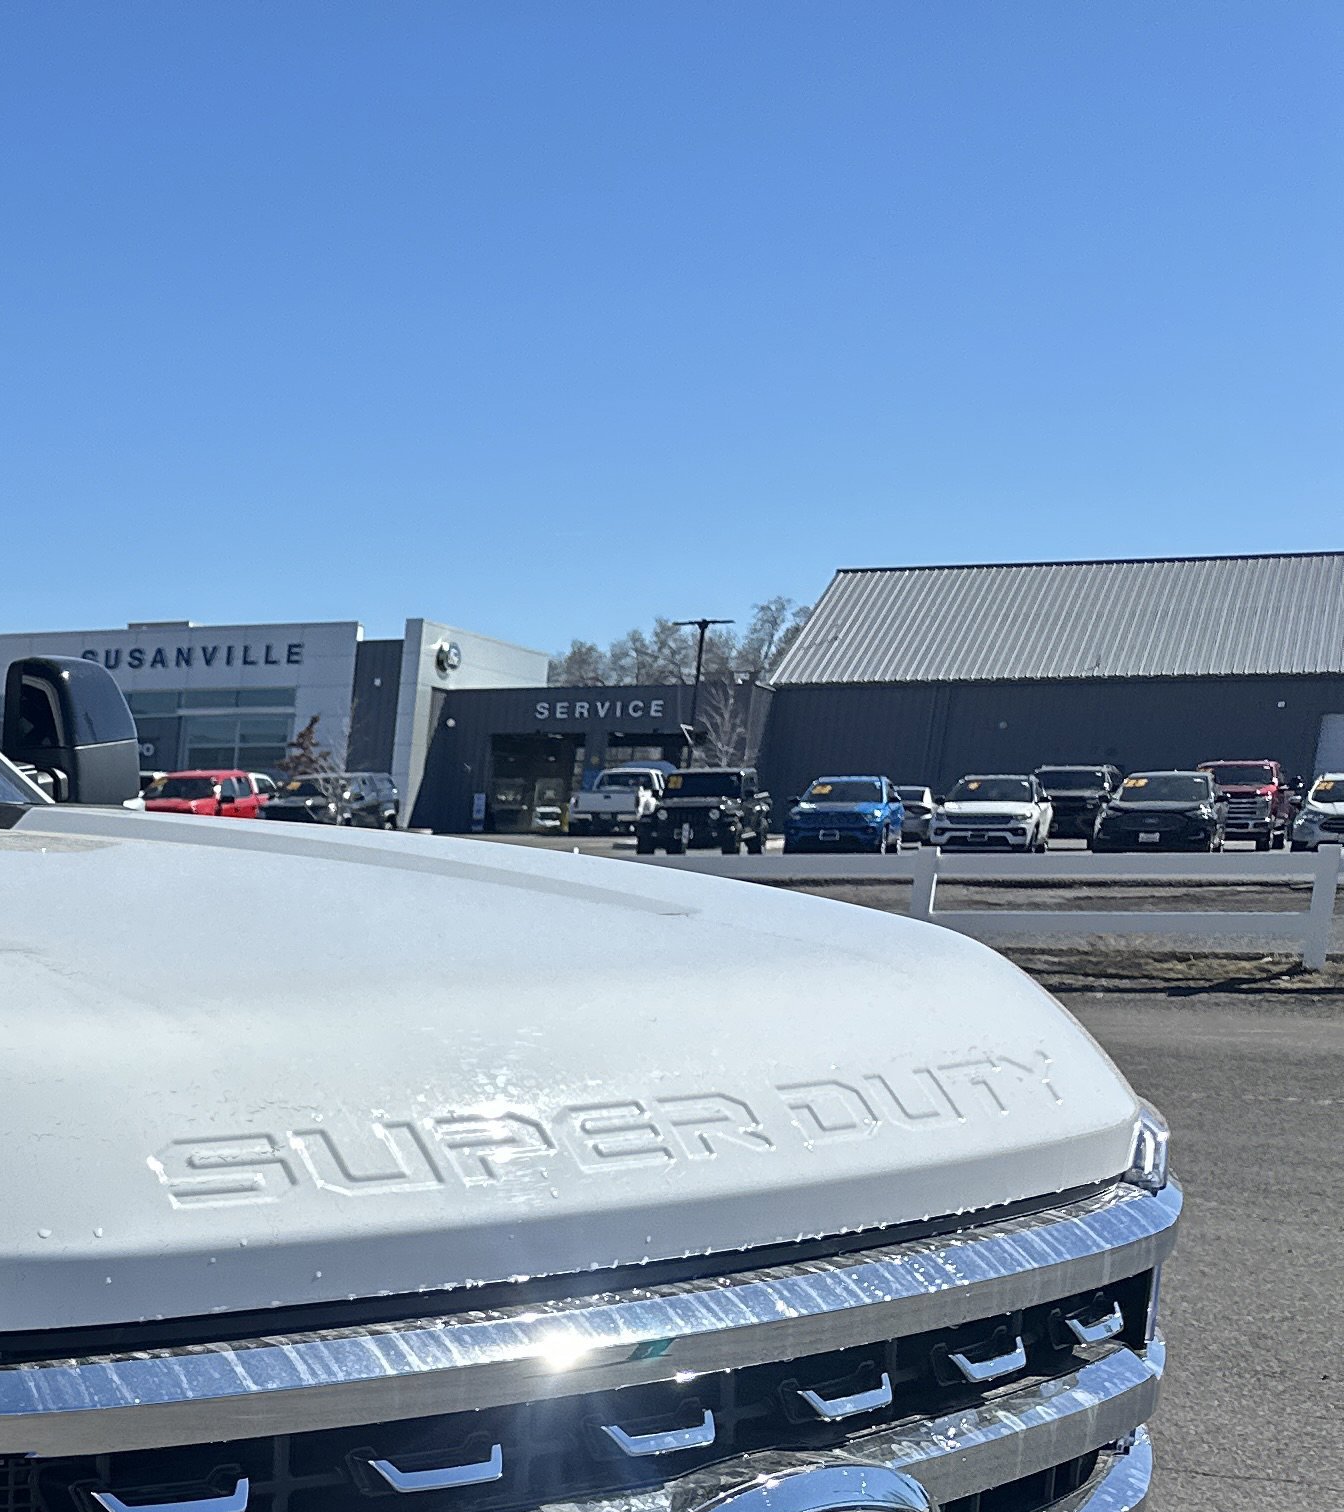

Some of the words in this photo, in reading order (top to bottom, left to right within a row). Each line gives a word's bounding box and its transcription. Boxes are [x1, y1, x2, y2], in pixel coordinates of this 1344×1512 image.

[535, 699, 665, 720] SERVICE
[146, 1092, 774, 1210] SUPER
[776, 1048, 1063, 1147] DUTY
